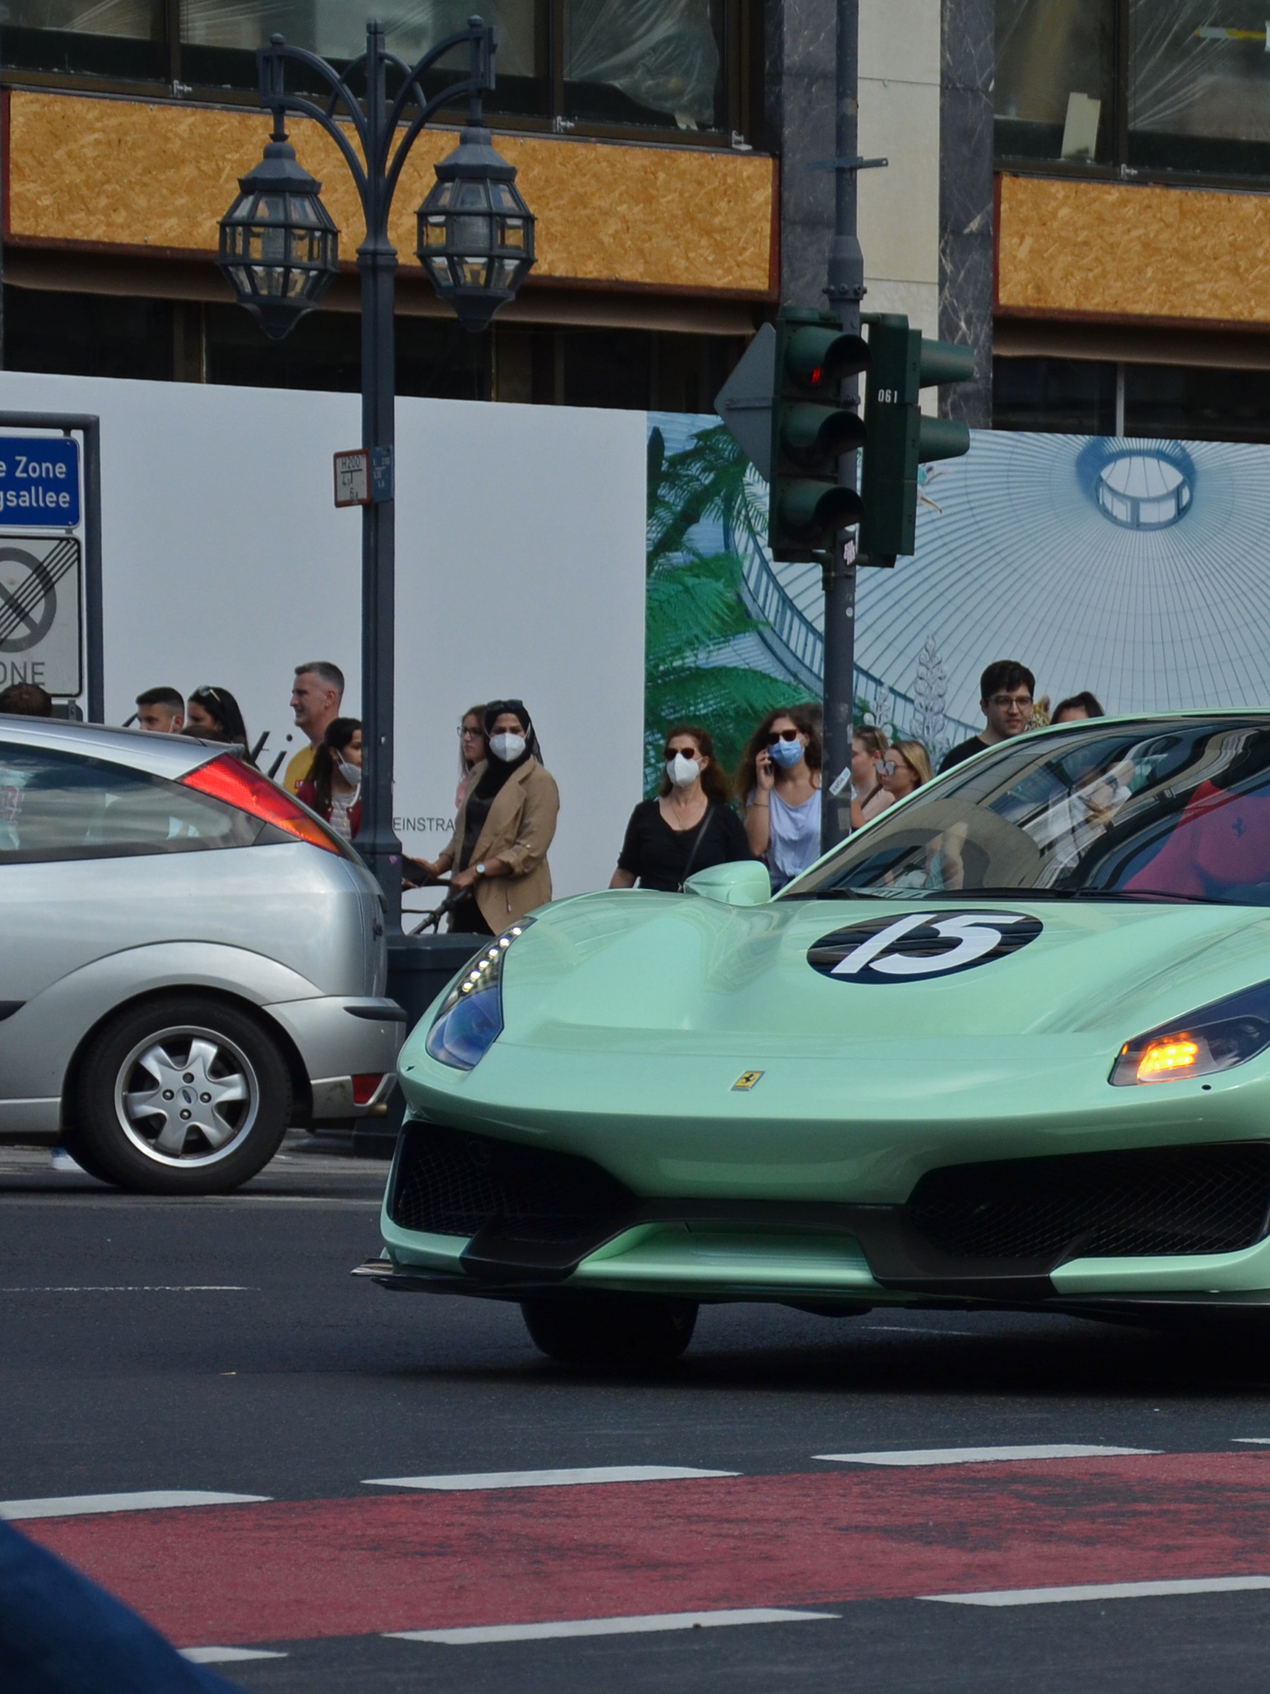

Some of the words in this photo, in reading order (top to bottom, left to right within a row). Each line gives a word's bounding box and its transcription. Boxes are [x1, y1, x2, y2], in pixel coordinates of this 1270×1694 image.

[877, 388, 898, 404] 061
[15, 455, 67, 479] Zone
[830, 913, 1027, 975] 15
